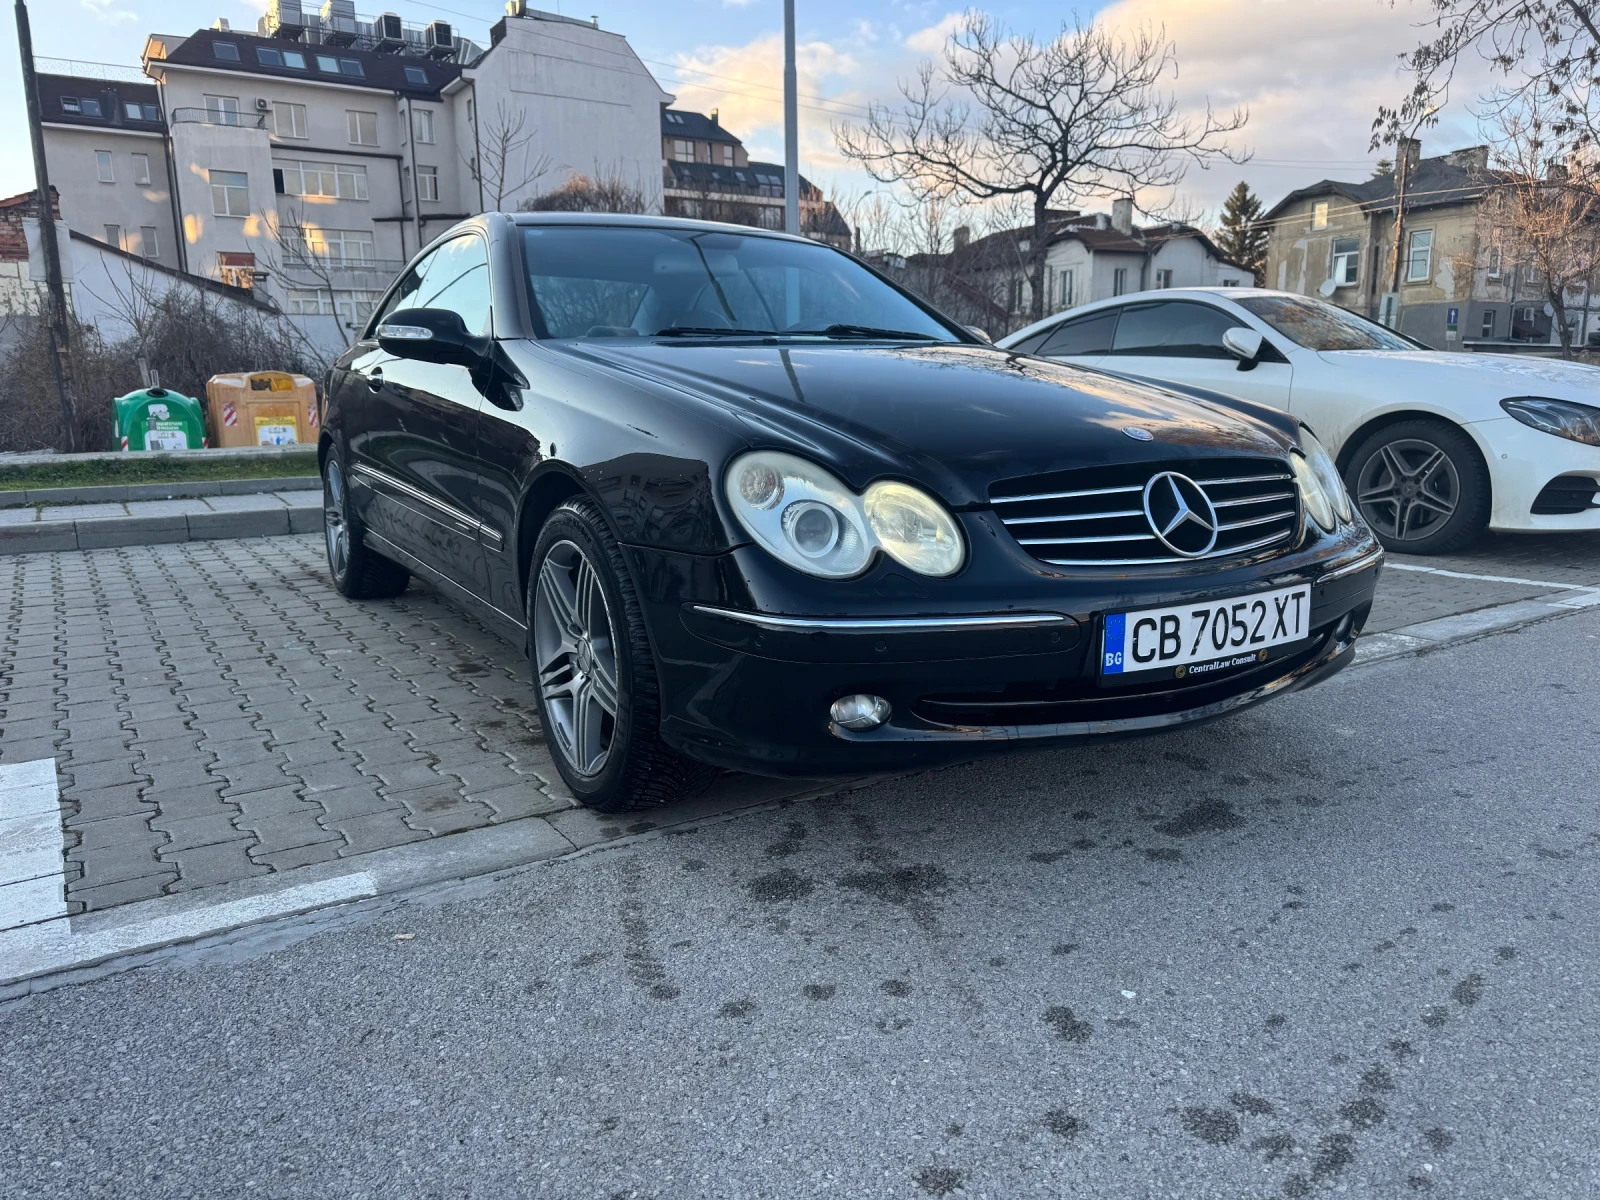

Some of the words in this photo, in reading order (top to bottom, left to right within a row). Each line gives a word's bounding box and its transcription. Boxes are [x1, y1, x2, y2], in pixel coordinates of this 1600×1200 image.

[1131, 614, 1181, 663] CB
[1190, 600, 1267, 656] 7052
[1272, 591, 1306, 640] XT
[1105, 652, 1122, 667] BG
[1189, 660, 1231, 674] CentralLaw
[1231, 653, 1257, 666] Consult
